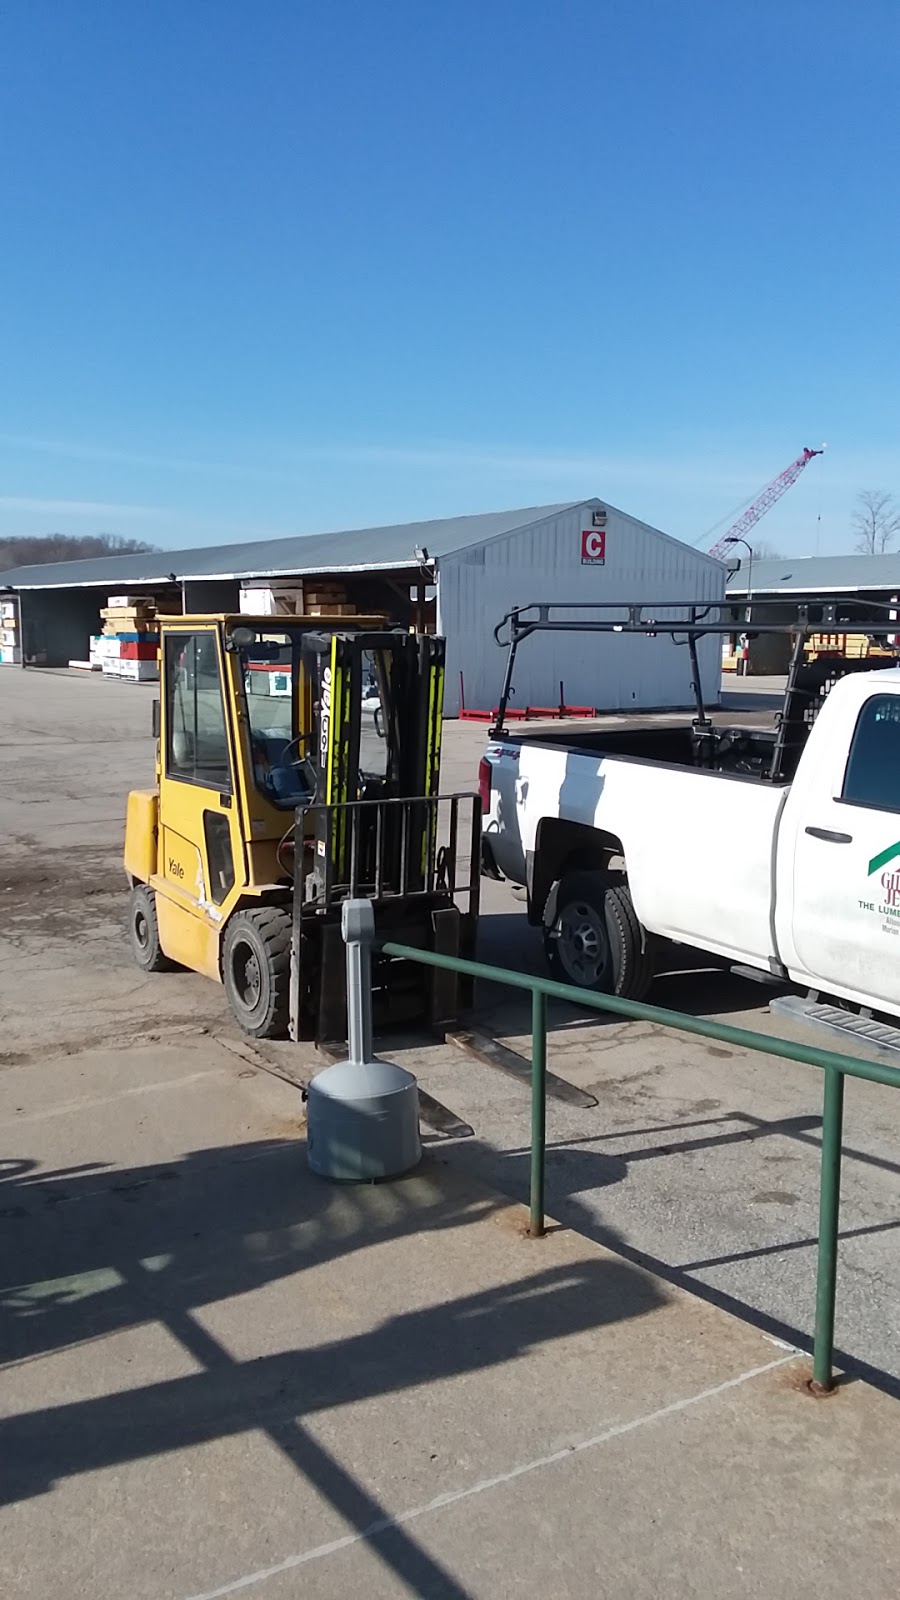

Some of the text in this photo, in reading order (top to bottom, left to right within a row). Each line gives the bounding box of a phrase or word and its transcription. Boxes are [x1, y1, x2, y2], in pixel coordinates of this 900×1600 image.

[585, 532, 602, 557] C
[169, 857, 184, 879] Yale
[858, 900, 875, 911] THE
